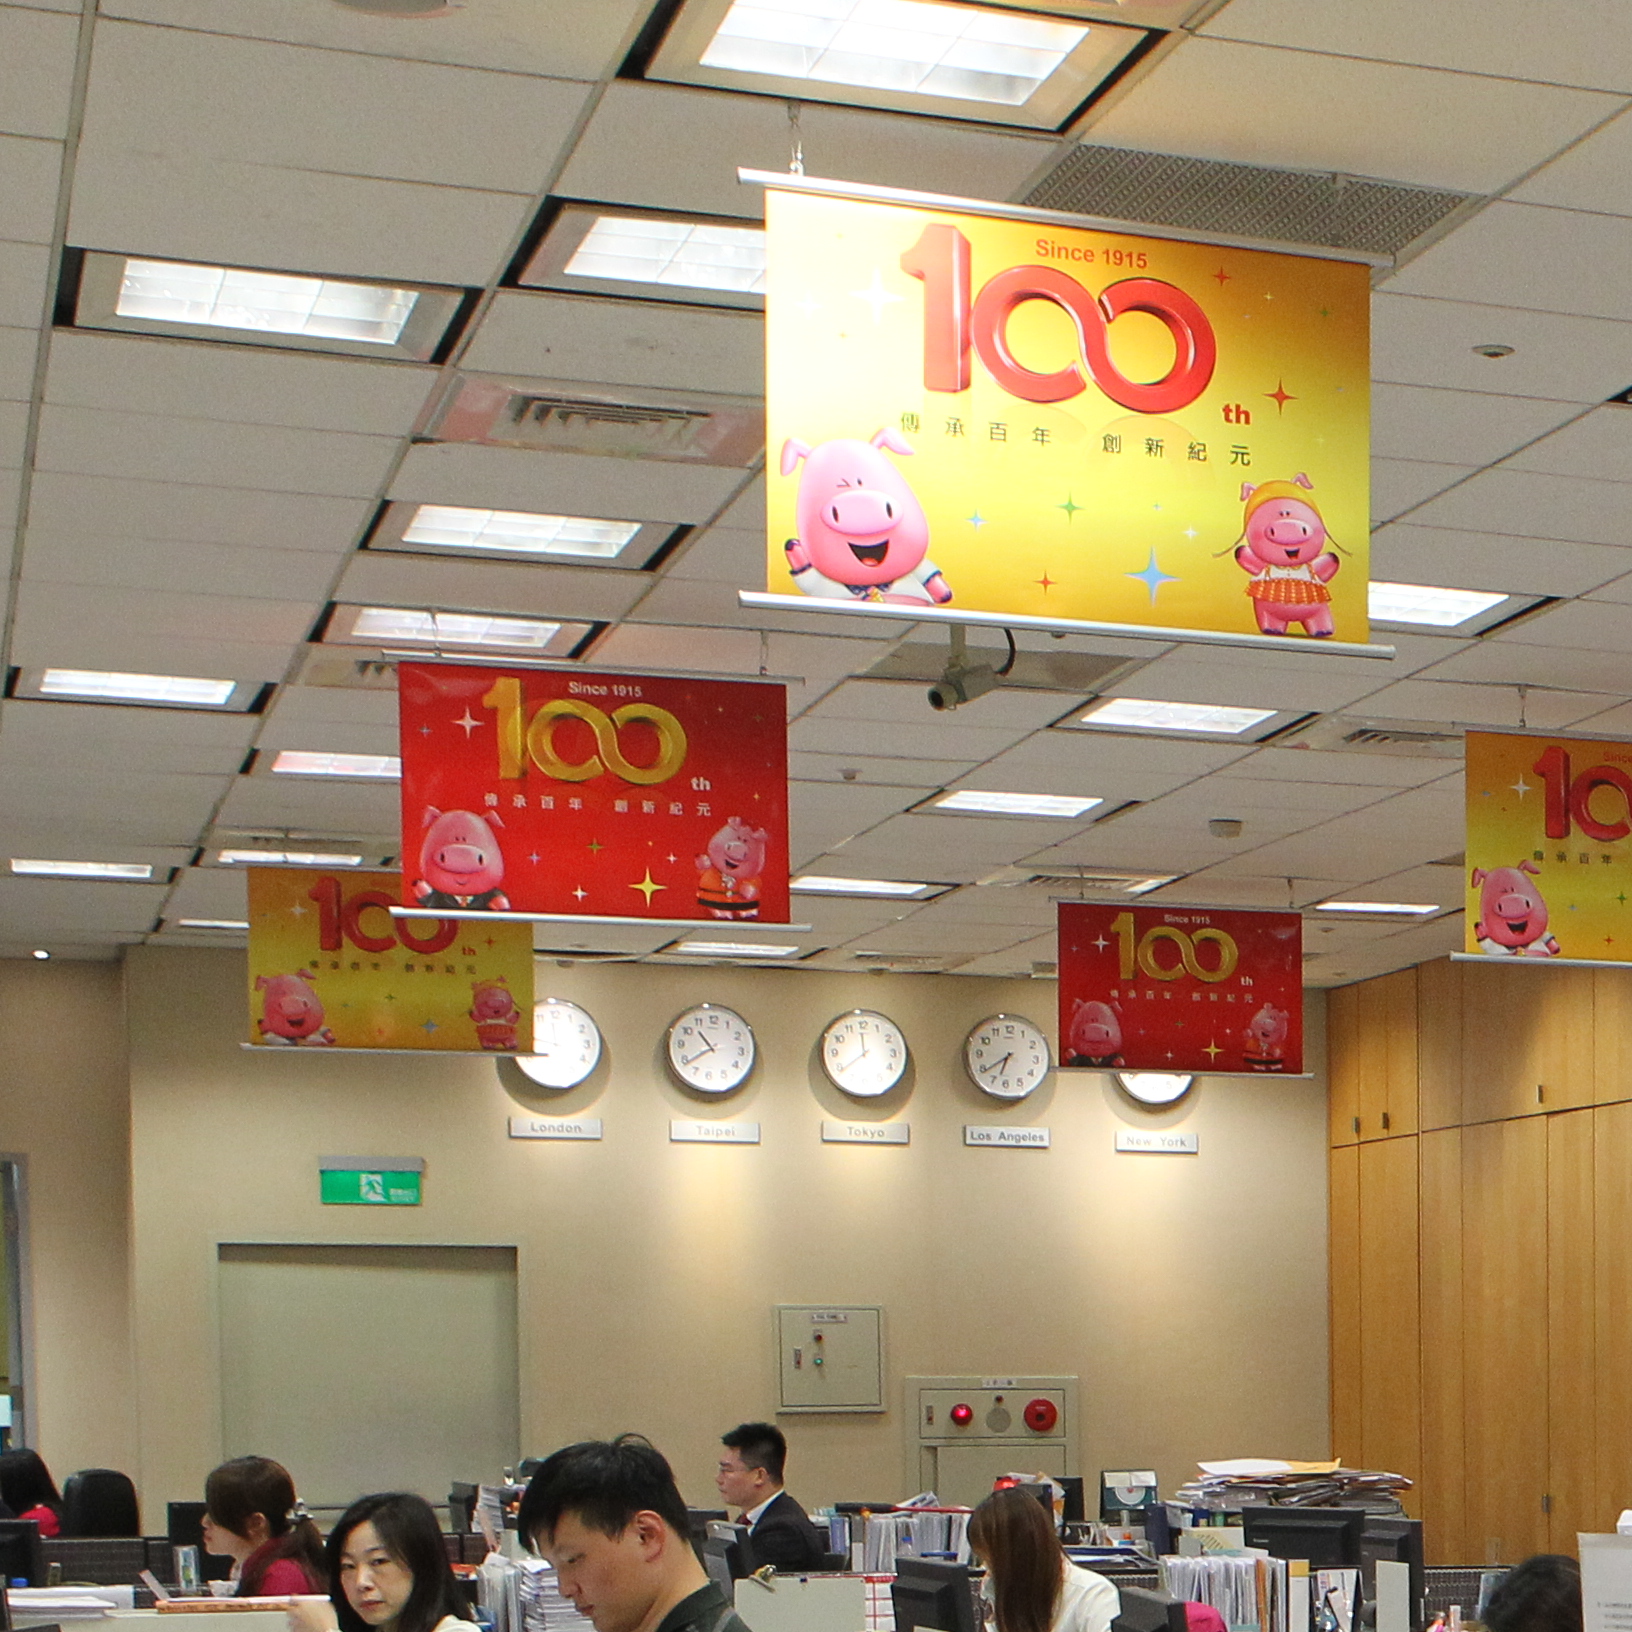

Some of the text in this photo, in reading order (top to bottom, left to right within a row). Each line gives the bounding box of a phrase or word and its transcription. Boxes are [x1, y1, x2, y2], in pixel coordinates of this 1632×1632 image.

[1036, 238, 1147, 269] Since 1915
[901, 223, 1251, 426] 100 th
[900, 412, 1251, 467] 傳承百年 創新紀元
[568, 680, 643, 698] Since 1915
[482, 677, 711, 791] 100 th
[1164, 914, 1210, 925] Since 1915
[1110, 912, 1253, 987] 100 th
[530, 1122, 582, 1133] London
[696, 1126, 736, 1138] Taipei
[847, 1127, 885, 1139] Tokyo
[970, 1132, 1045, 1145] Los Angeles
[1126, 1136, 1187, 1147] New York
